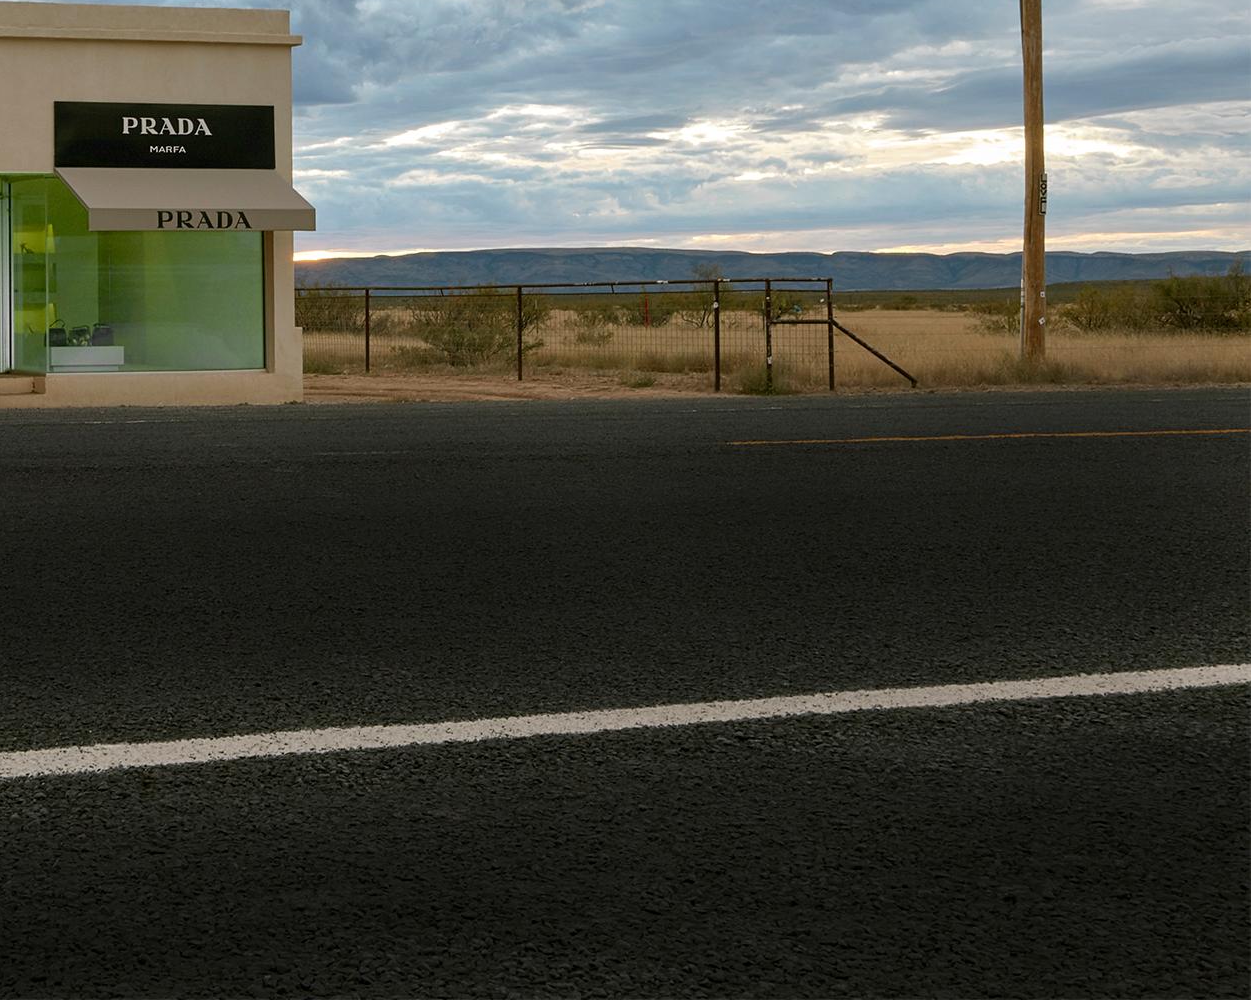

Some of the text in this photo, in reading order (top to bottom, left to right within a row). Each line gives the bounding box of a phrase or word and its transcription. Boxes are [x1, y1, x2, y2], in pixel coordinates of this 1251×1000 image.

[122, 116, 213, 136] PRADA
[149, 145, 187, 154] MARFA
[157, 210, 253, 229] PRADA
